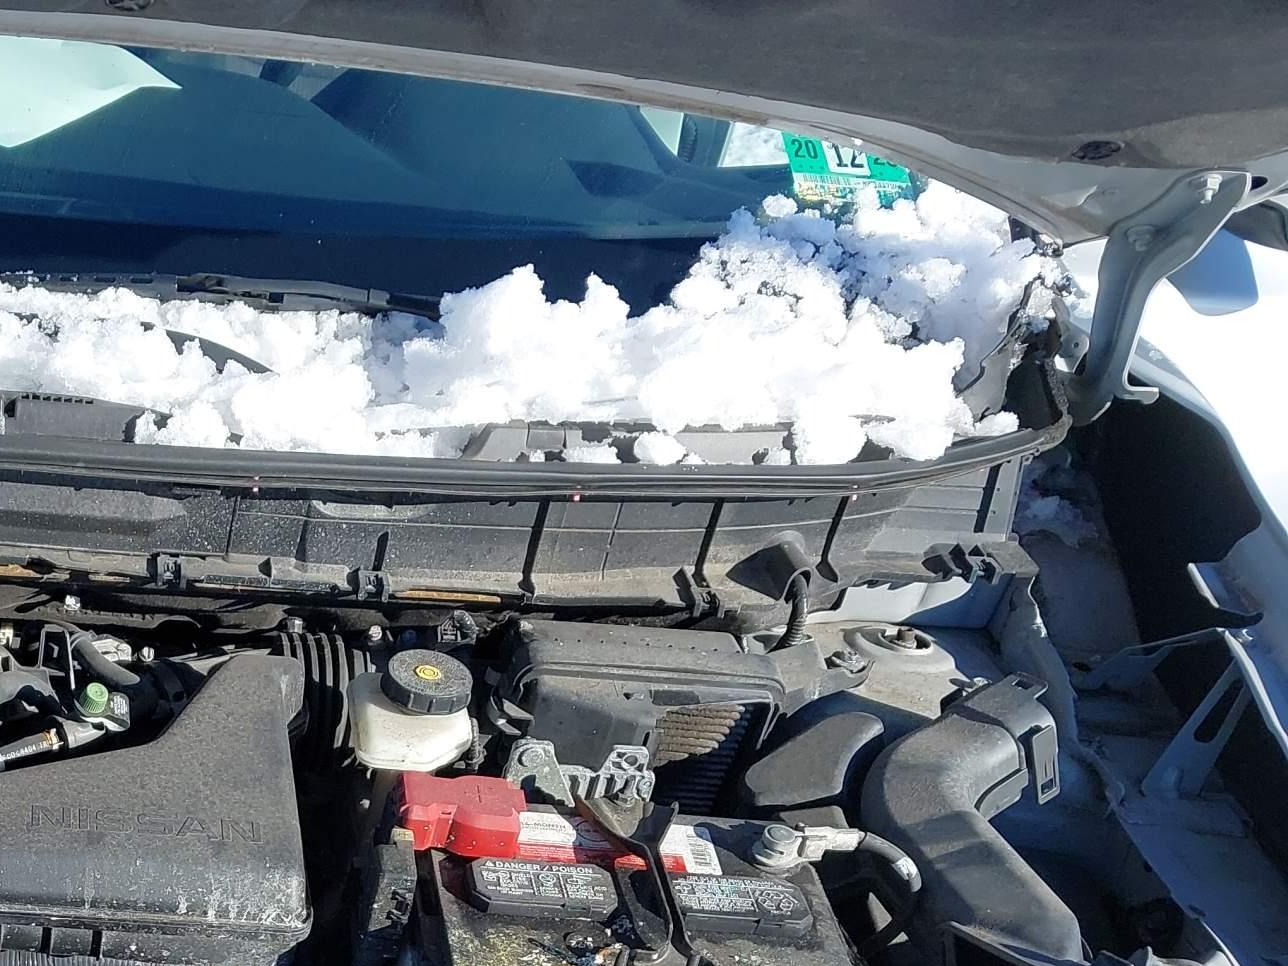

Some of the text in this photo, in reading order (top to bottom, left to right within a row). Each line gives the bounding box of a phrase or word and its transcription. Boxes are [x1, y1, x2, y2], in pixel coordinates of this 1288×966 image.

[791, 138, 818, 159] 20
[30, 804, 263, 845] NISSAN
[496, 861, 540, 870] DANGER
[552, 866, 593, 874] POISON
